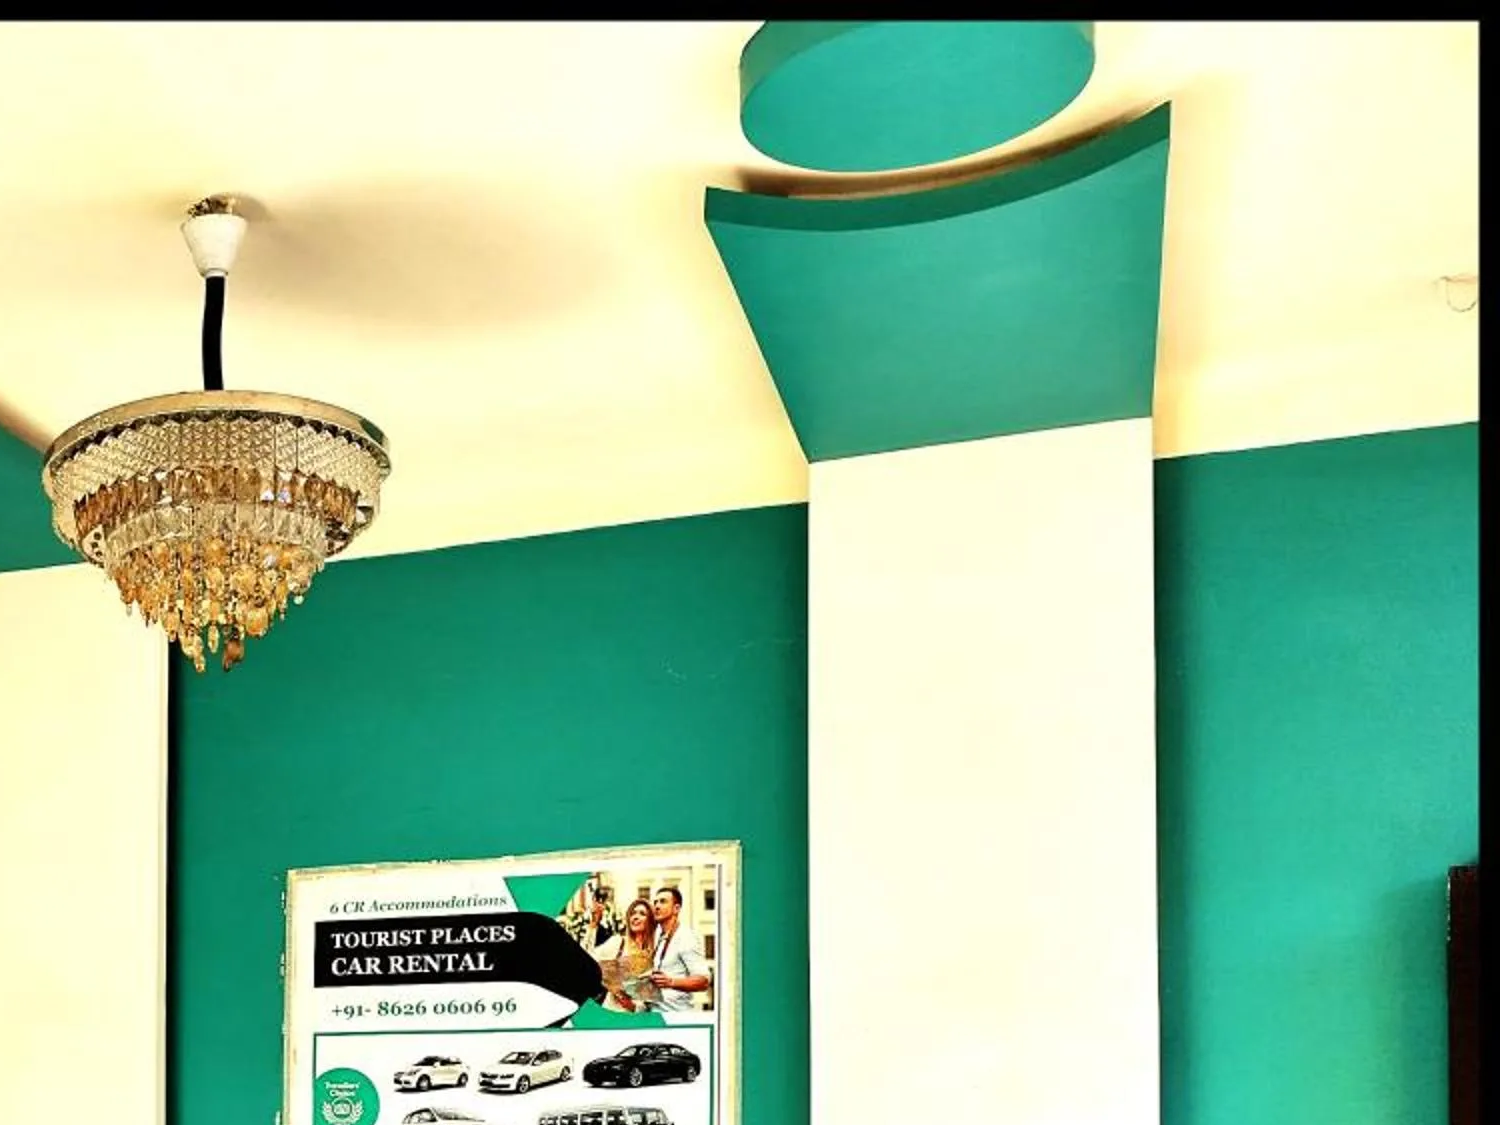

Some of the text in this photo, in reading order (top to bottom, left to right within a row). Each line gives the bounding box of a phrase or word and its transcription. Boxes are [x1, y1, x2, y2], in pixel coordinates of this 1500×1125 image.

[329, 894, 507, 914] 6 CR Accommodations
[330, 925, 516, 949] TOURIST PLACES
[331, 952, 494, 976] CAR RENTAL
[331, 998, 517, 1020] +91- 8626 0606 96
